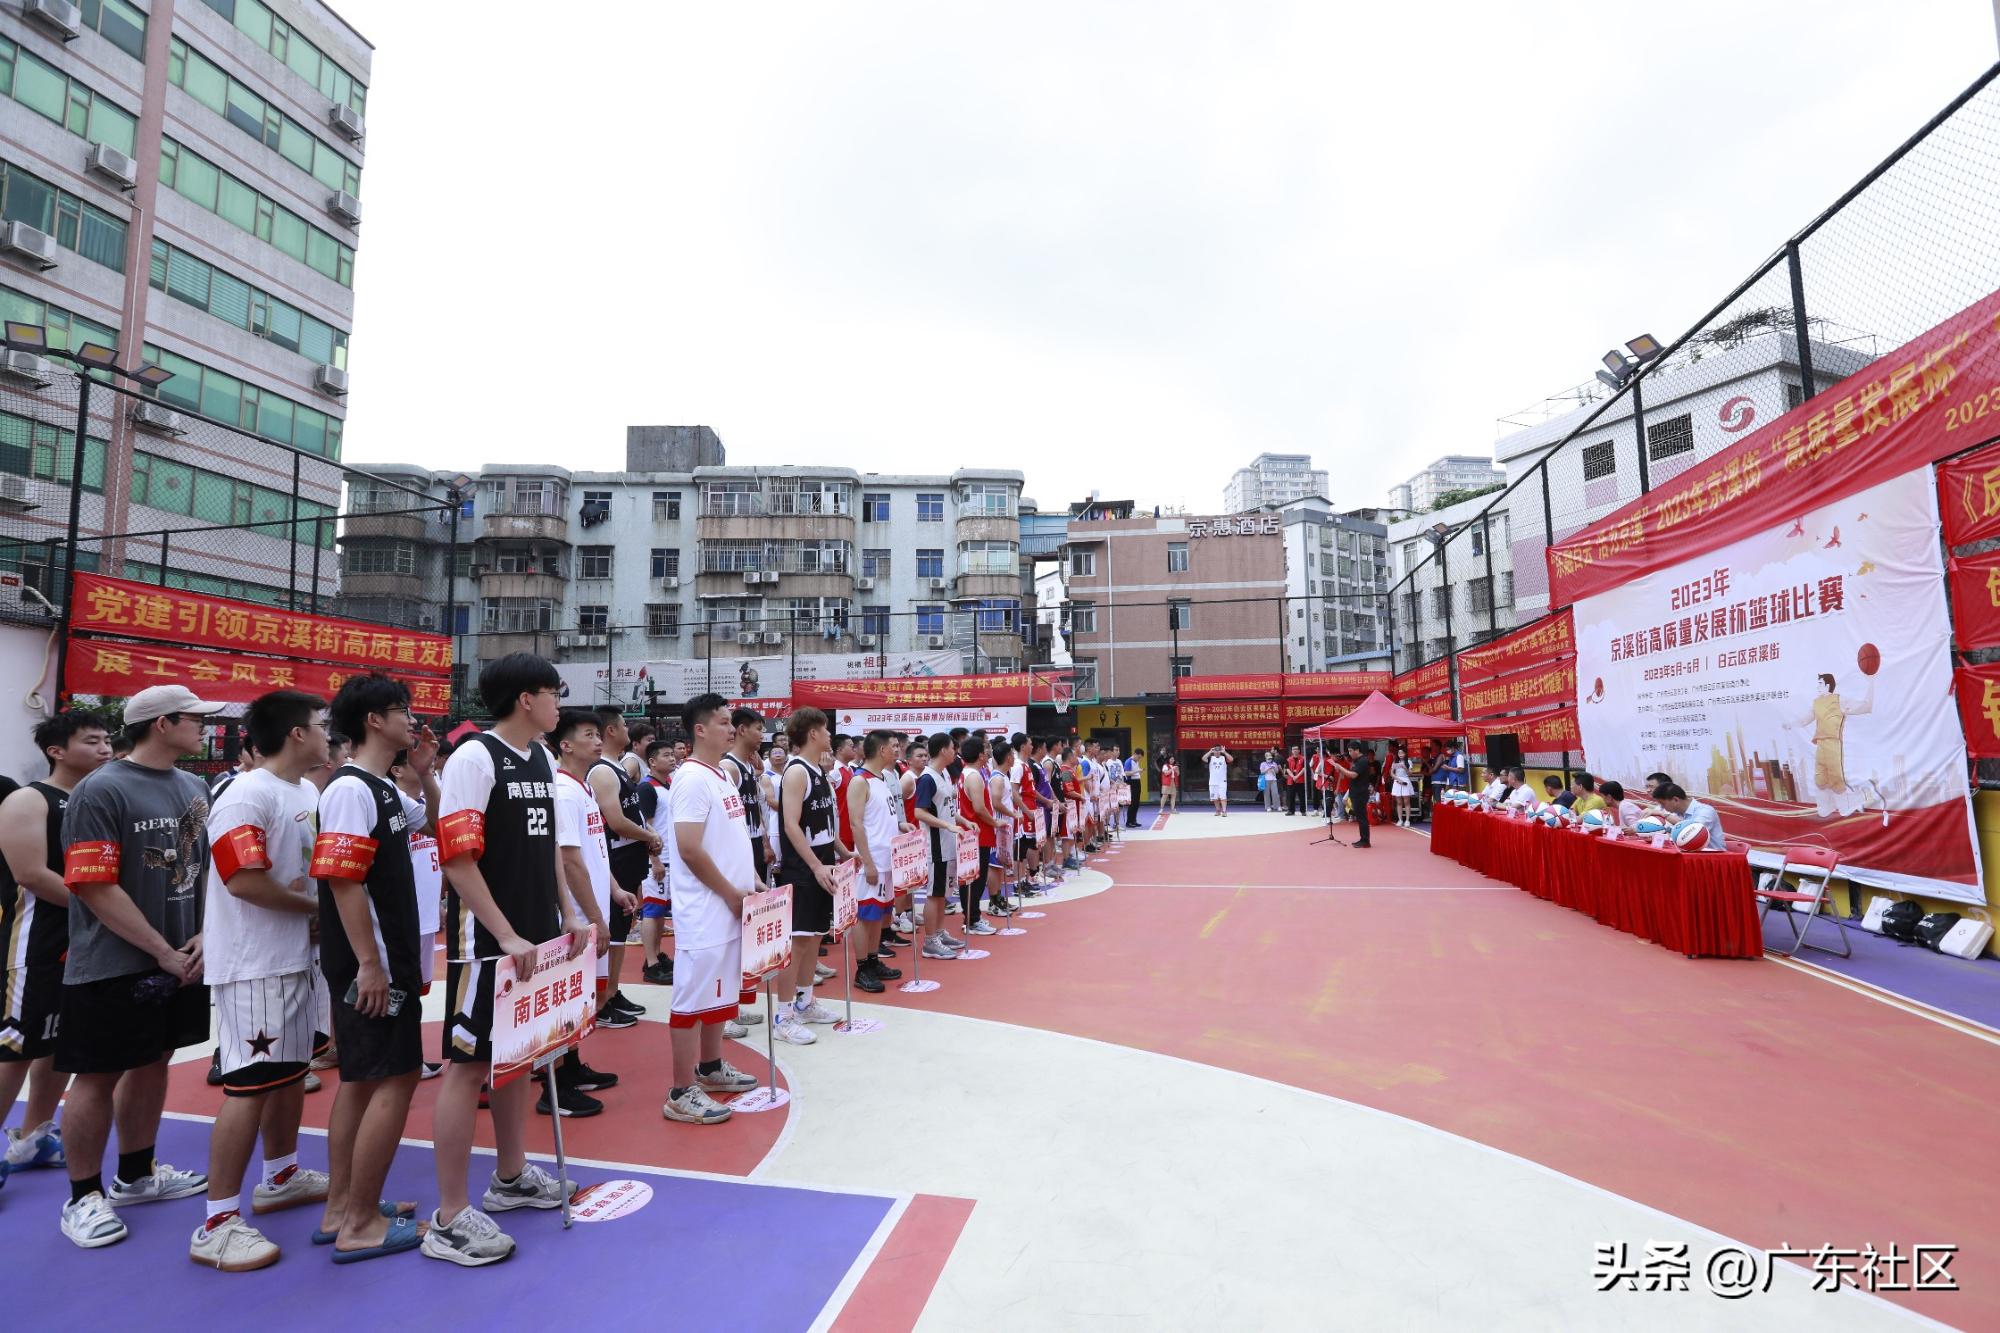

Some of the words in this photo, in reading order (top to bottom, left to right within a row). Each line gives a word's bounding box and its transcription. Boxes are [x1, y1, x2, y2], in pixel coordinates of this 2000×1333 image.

[1188, 515, 1280, 539] 京惠酒店
[1671, 567, 1731, 611] 2023年
[1610, 574, 1845, 663] 京溪街高质量发展杯篮球比赛
[92, 648, 297, 690] 展工会风采
[526, 807, 549, 836] 22
[657, 881, 665, 895] 3
[513, 970, 584, 1029] 南医联盟
